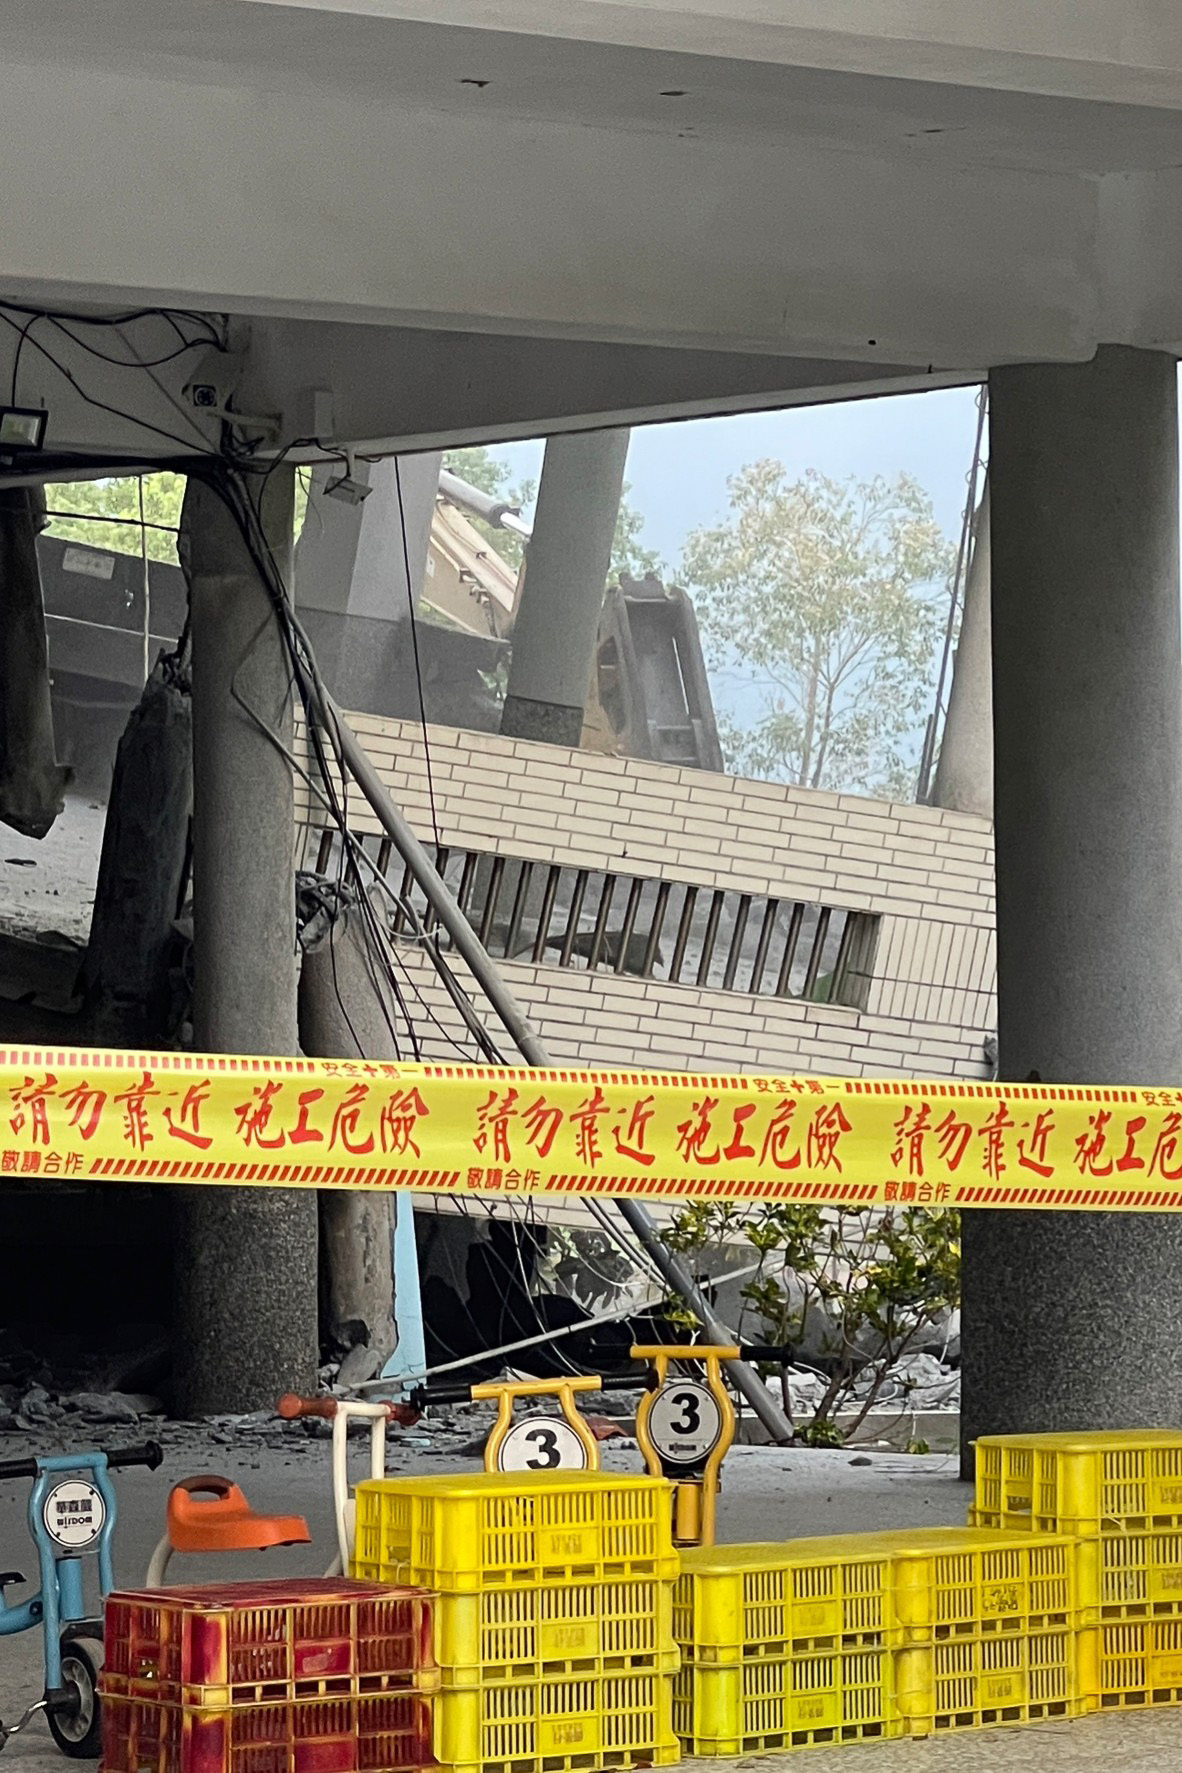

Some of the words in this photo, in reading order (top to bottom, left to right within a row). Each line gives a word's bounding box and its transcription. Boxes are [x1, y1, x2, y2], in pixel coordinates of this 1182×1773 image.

[8, 1070, 214, 1151] 請勿靠近
[234, 1080, 430, 1158] 施工危險
[472, 1086, 657, 1168] 請勿靠近
[676, 1096, 854, 1172] 施工危險
[889, 1100, 1056, 1180] 請勿靠近
[1, 1150, 85, 1174] 敬請合作
[466, 1166, 541, 1191] 敬請合作
[884, 1180, 950, 1202] 敬請合作
[670, 1392, 701, 1435] 3
[525, 1428, 561, 1470] 3
